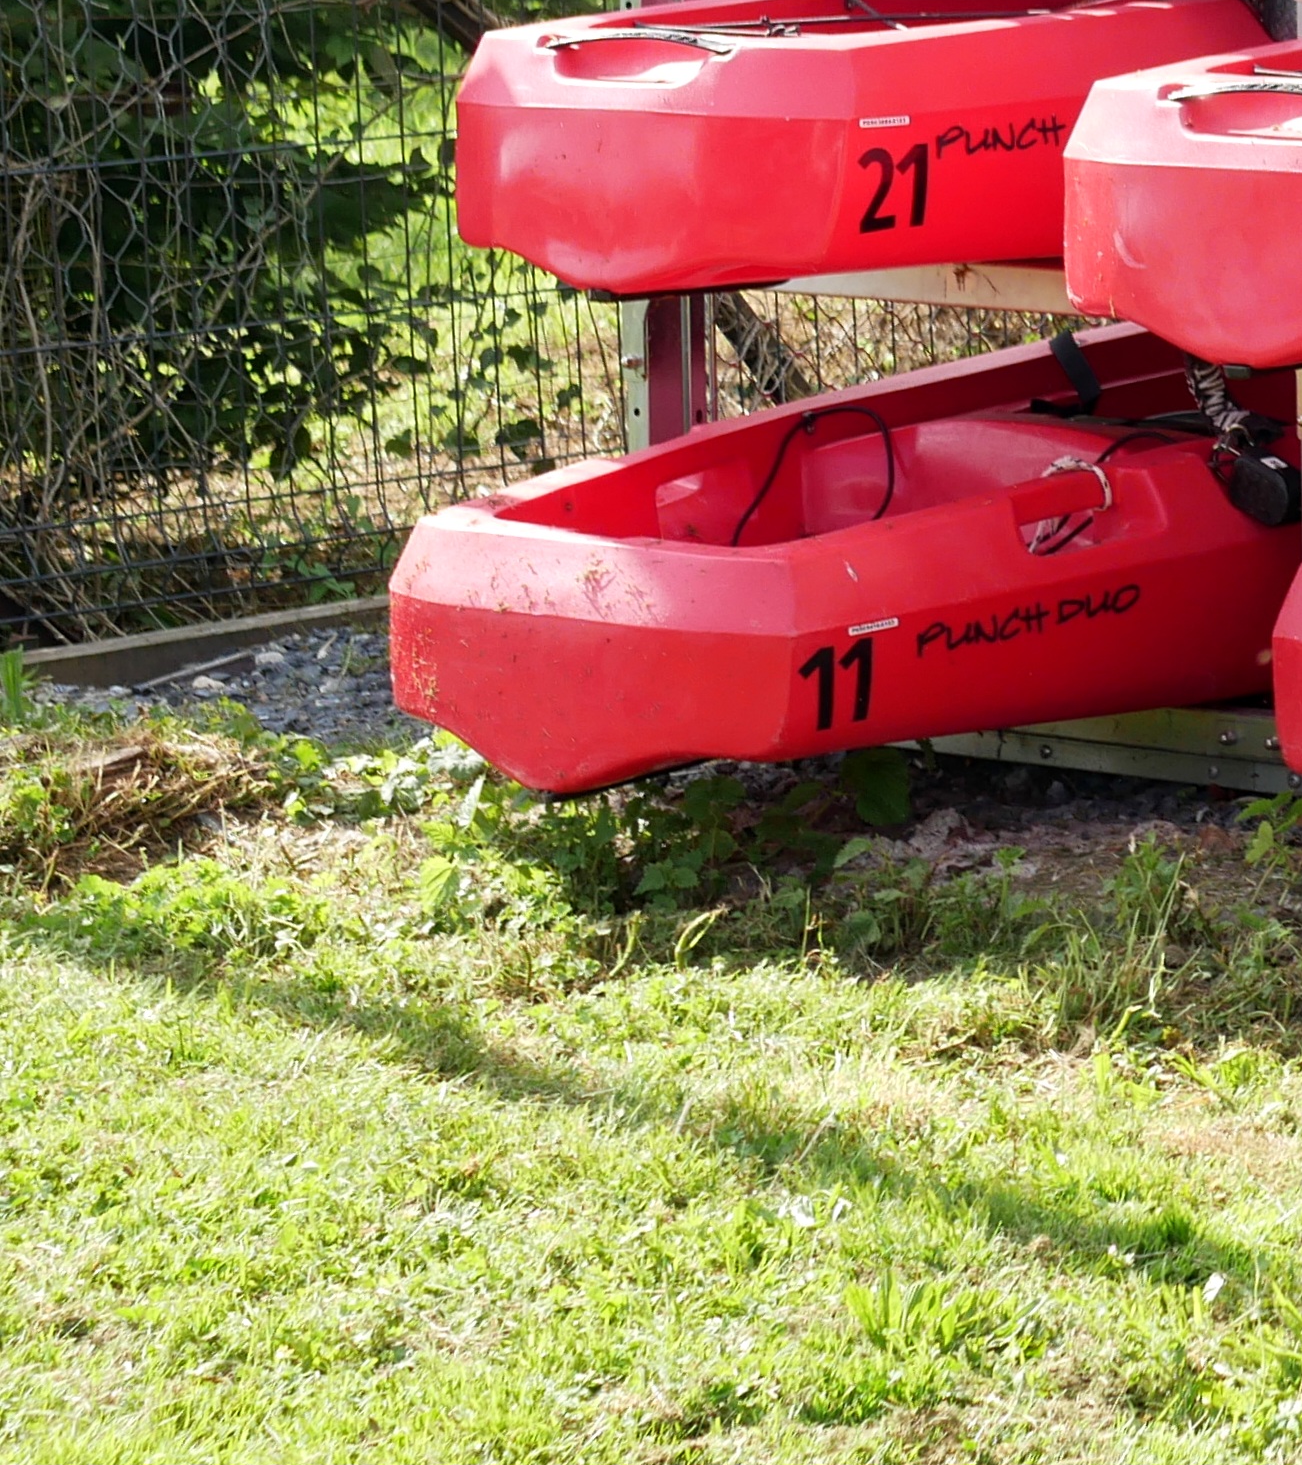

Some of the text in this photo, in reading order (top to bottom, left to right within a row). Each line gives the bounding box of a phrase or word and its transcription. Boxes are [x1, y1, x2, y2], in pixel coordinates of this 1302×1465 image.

[935, 115, 1065, 160] PUNCH
[857, 142, 930, 234] 21
[916, 583, 1141, 658] PUNCH DUO
[797, 636, 873, 731] 11
